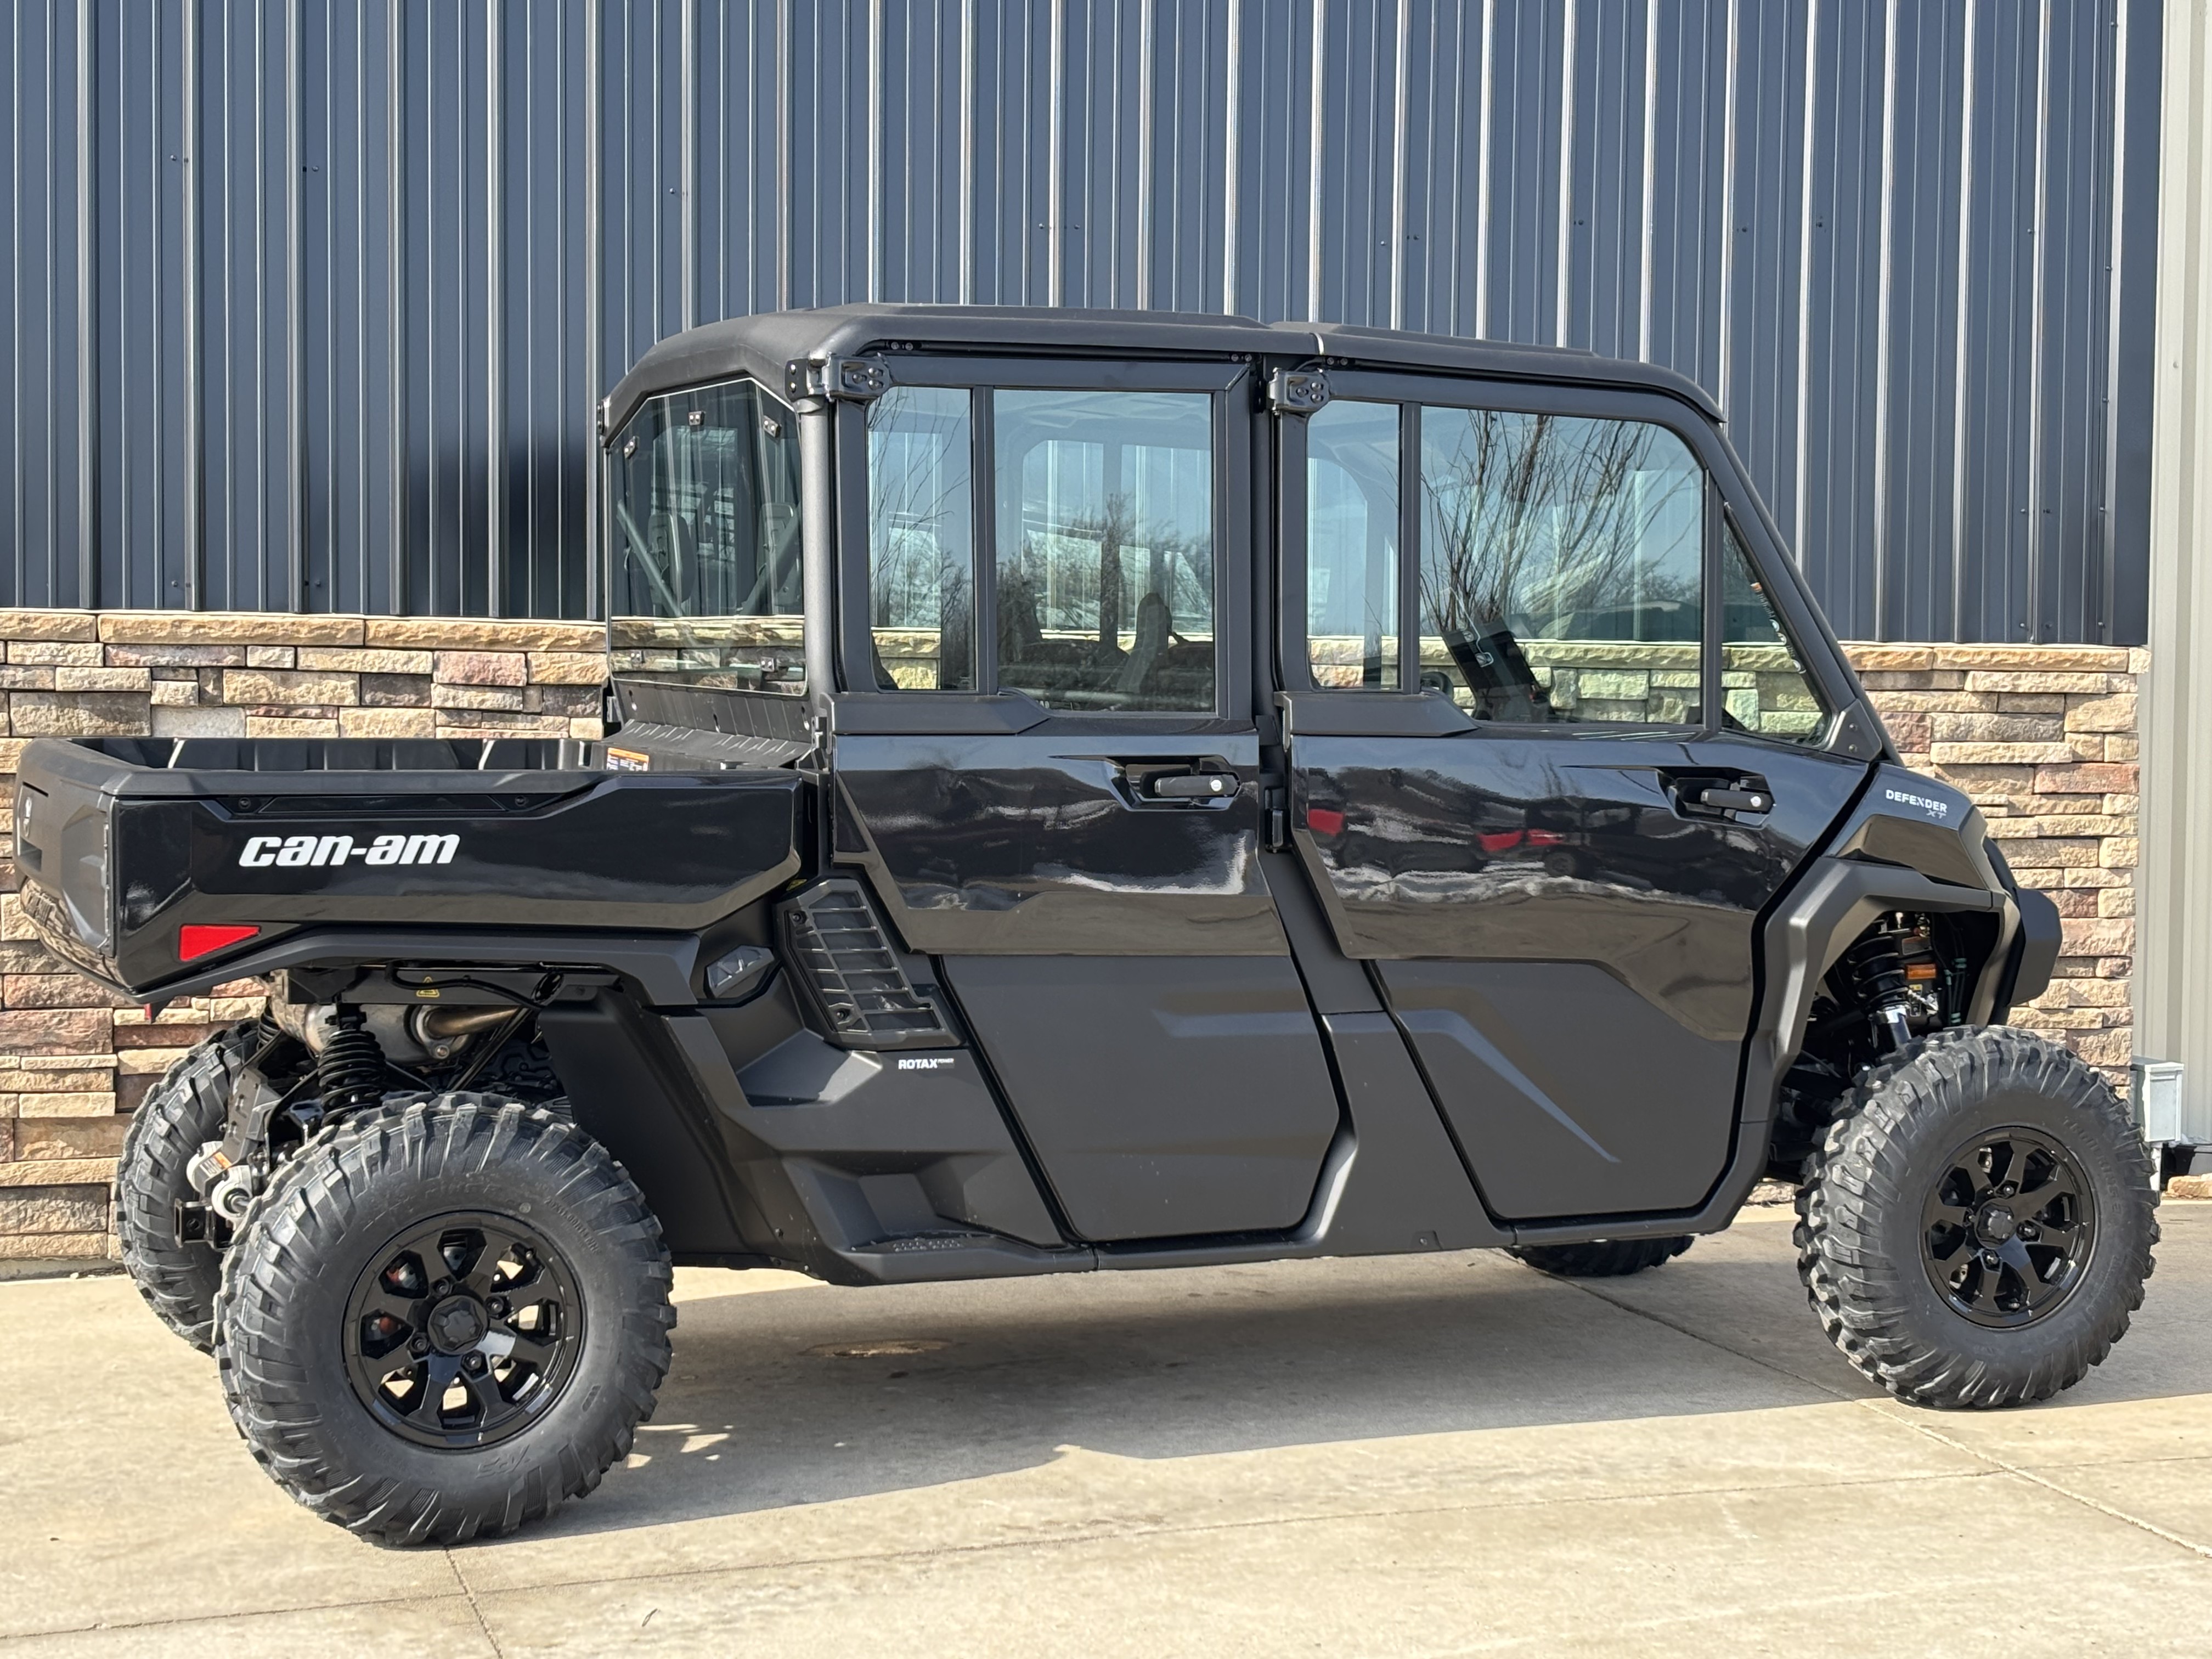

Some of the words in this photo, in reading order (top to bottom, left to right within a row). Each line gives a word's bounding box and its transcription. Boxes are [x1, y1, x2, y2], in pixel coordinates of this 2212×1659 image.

[1886, 789, 1948, 813] DEFENDER
[1926, 809, 1946, 819] XT
[238, 833, 461, 867] can-am
[898, 1058, 938, 1070] ROTAX
